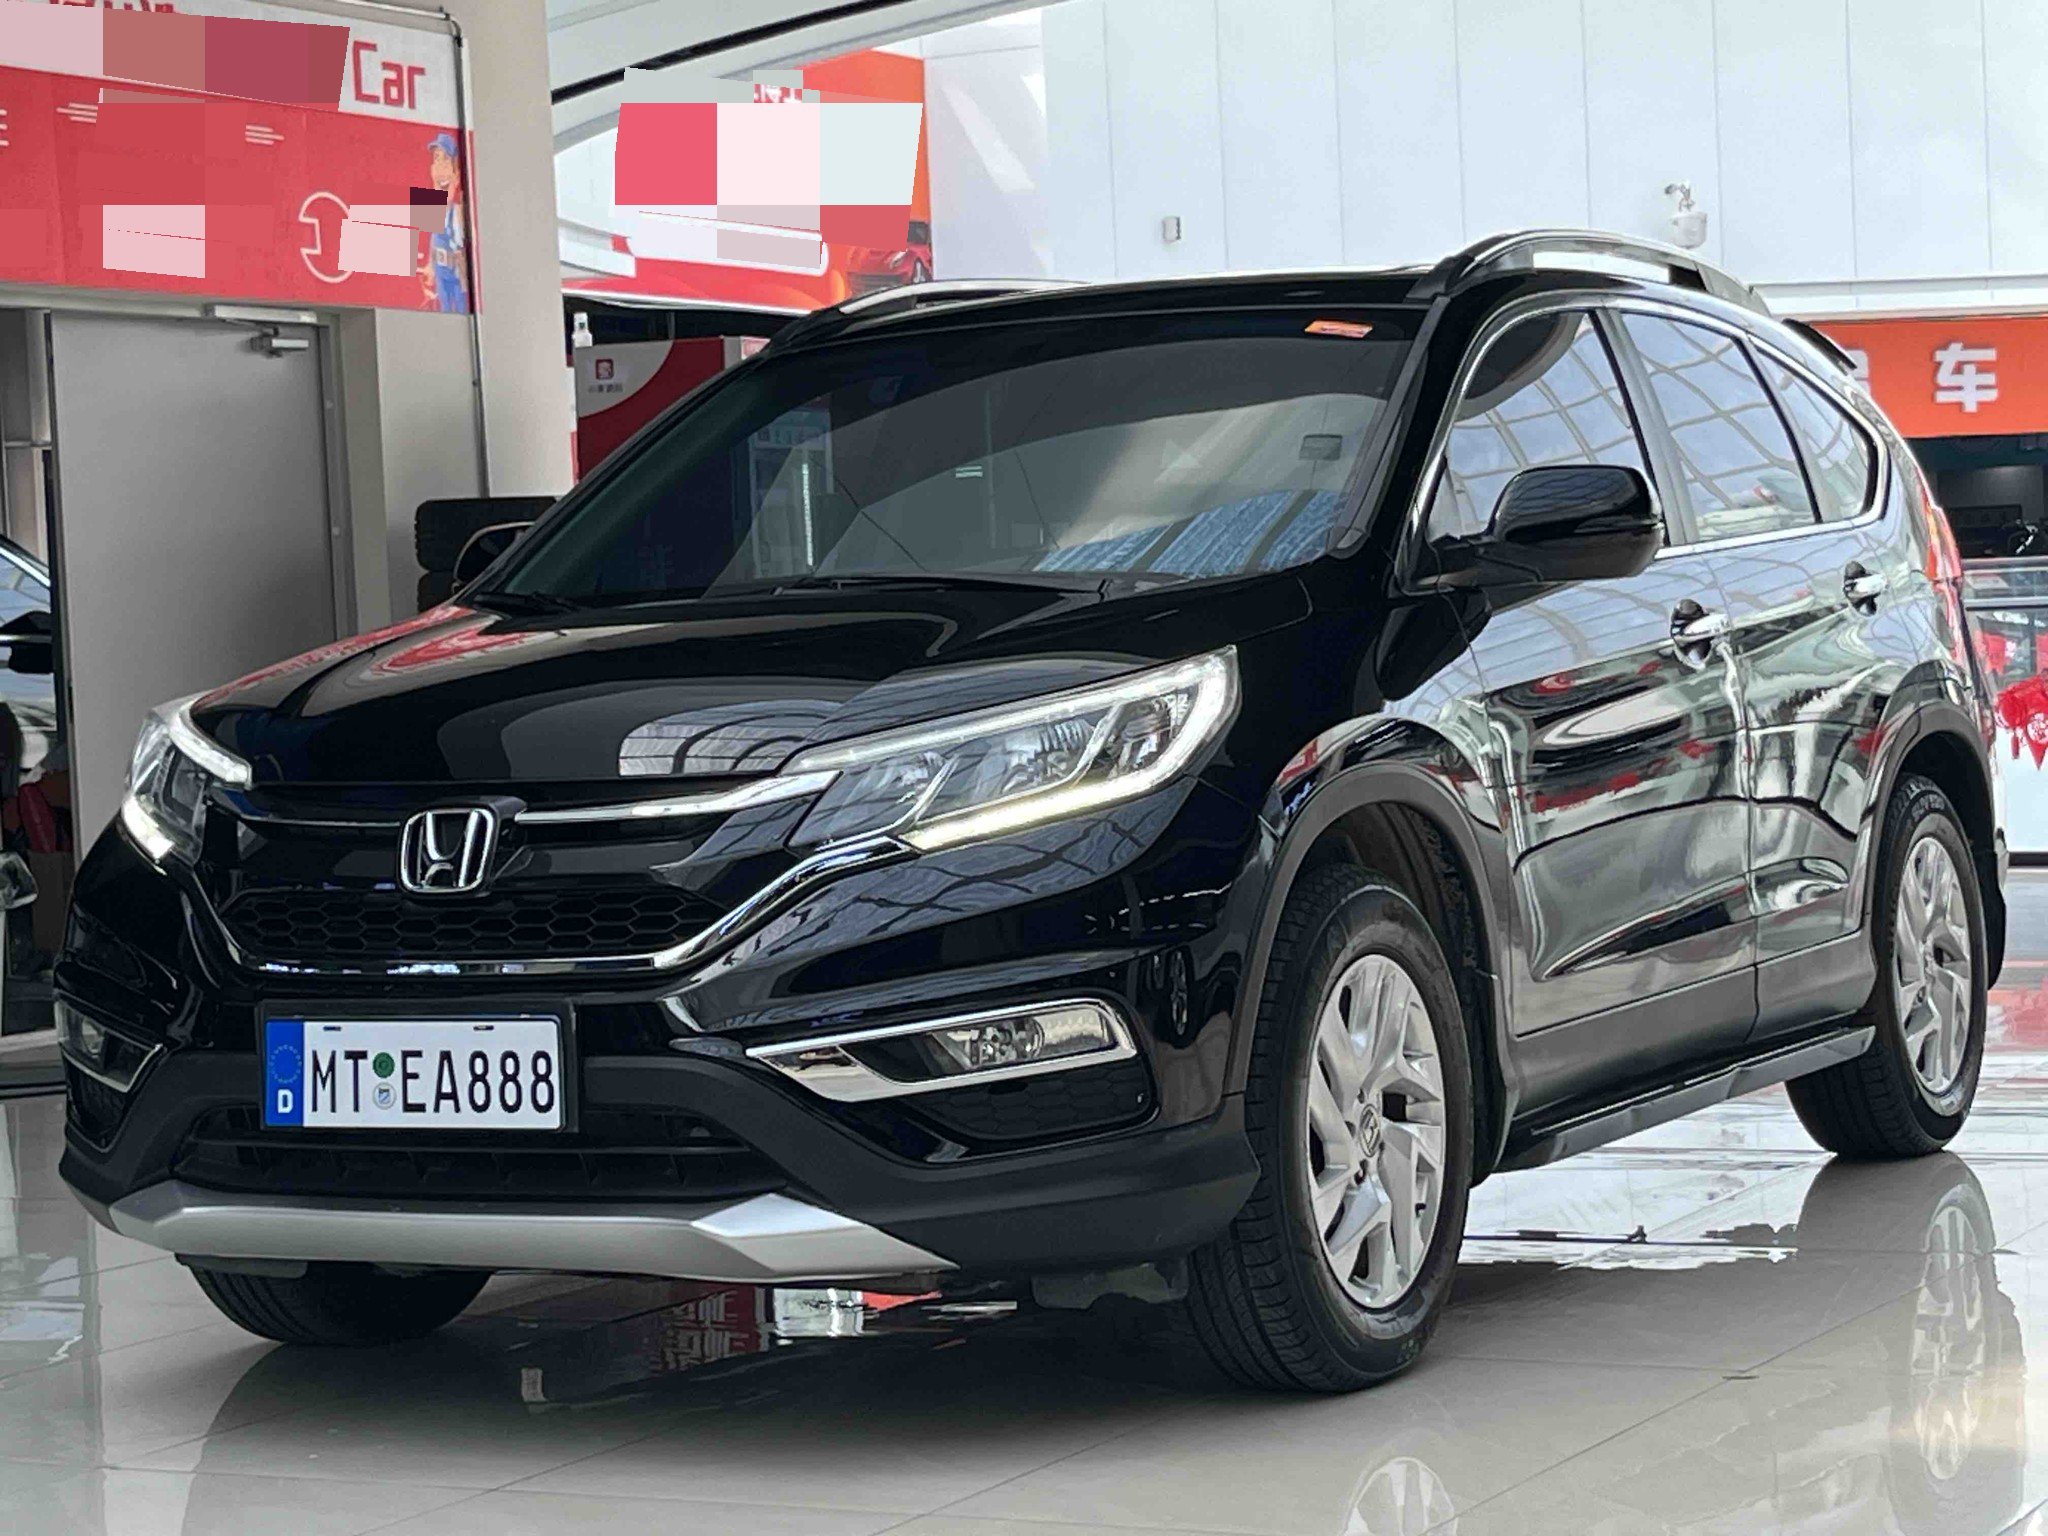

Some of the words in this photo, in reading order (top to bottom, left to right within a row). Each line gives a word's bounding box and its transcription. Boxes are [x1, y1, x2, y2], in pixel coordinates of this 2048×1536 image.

[352, 40, 426, 110] Car
[277, 1089, 293, 1113] D
[401, 1050, 555, 1113] EA888
